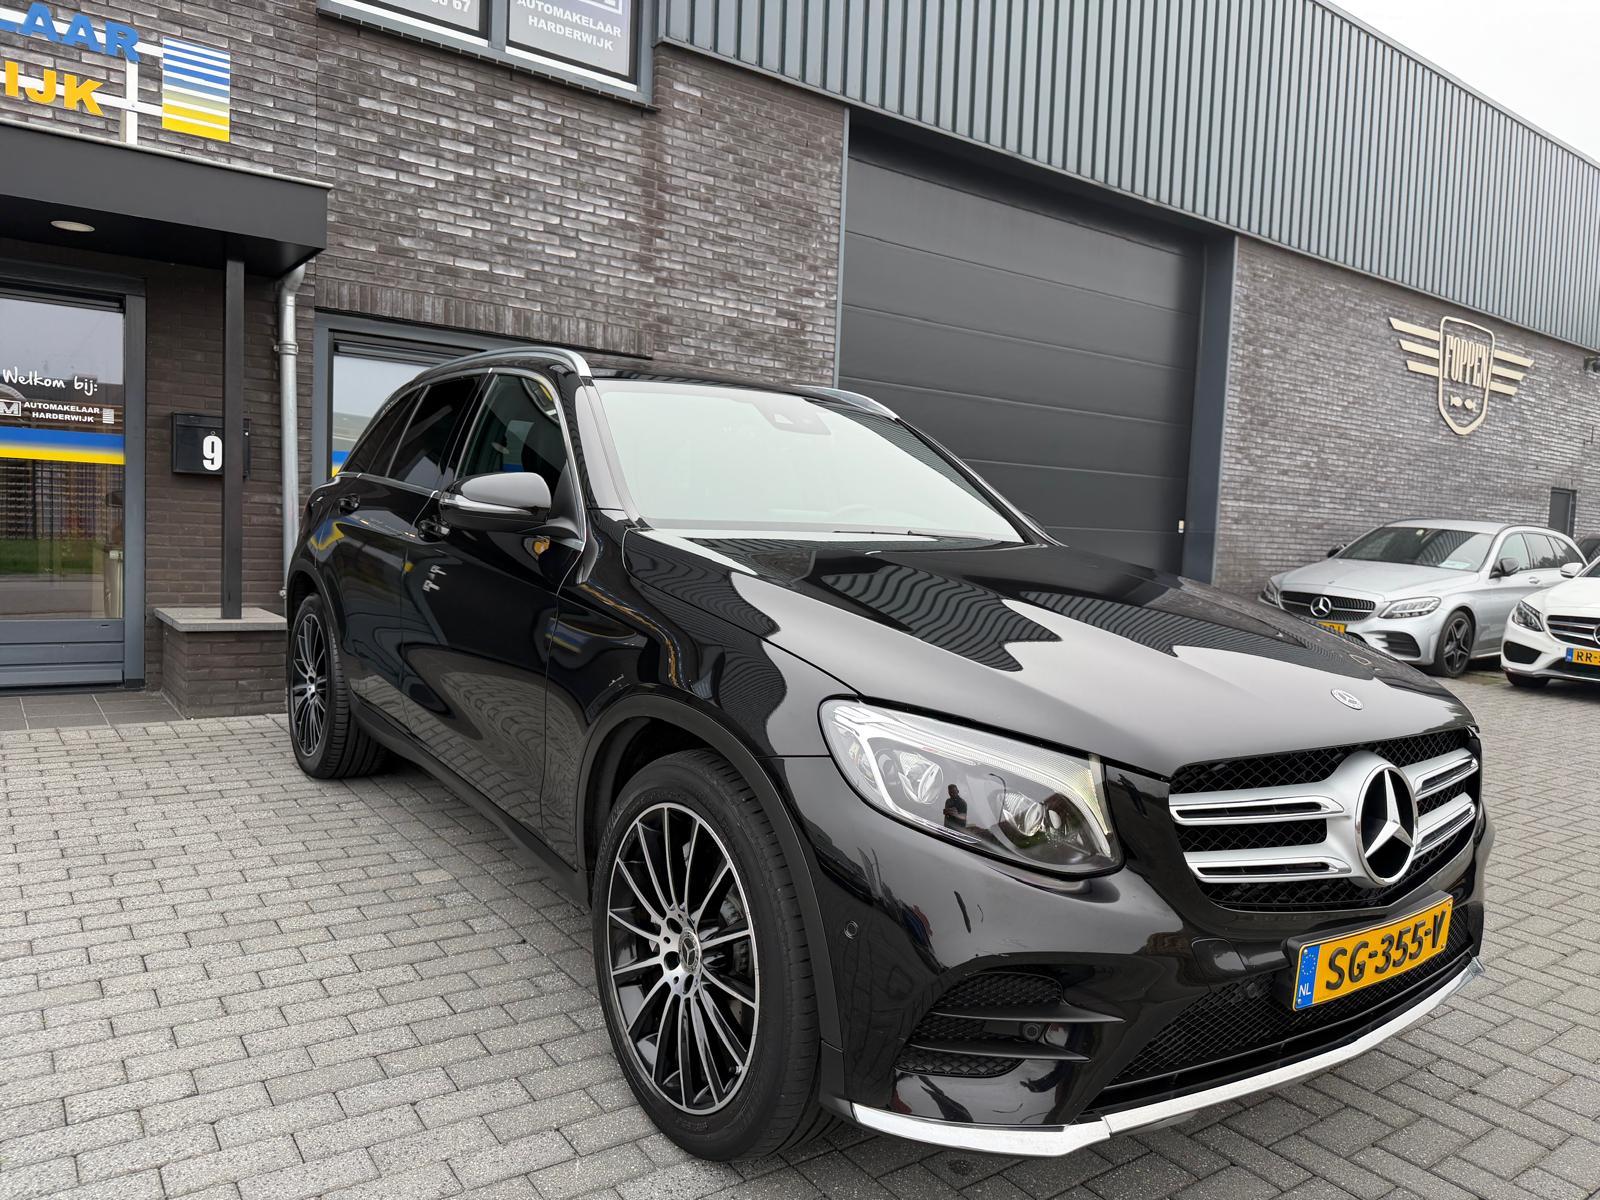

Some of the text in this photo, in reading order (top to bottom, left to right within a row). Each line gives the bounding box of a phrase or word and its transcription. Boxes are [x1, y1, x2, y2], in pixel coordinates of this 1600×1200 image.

[516, 0, 622, 38] AUTOMAKELAAR
[527, 15, 614, 52] HARDERWIJK
[1443, 334, 1490, 389] FOPPEN
[2, 367, 98, 396] Welkom bij:
[23, 401, 100, 414] AUTOMAKELAAR
[32, 411, 94, 423] HARDERWIJK
[203, 435, 223, 471] 9
[1576, 651, 1600, 663] RR-
[1325, 910, 1447, 990] SG-355-V
[1298, 982, 1312, 998] NL
